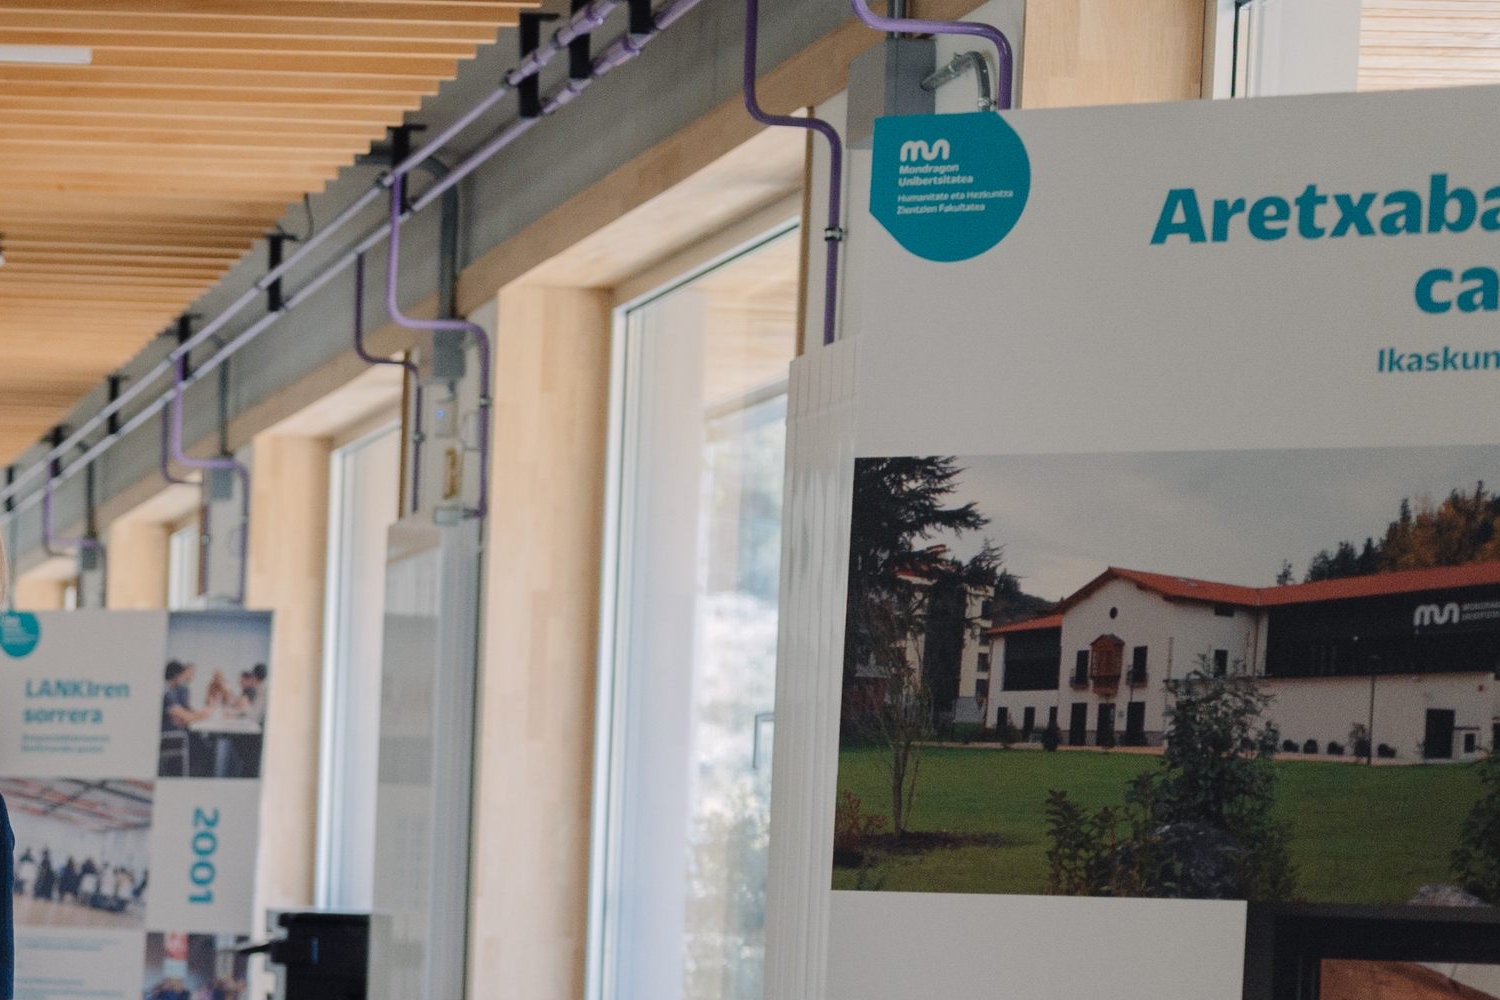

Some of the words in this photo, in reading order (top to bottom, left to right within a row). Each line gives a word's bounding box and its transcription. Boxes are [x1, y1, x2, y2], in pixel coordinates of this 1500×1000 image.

[899, 164, 959, 175] Mondragon
[898, 175, 974, 187] Unibertsitatea
[950, 191, 965, 201] eta
[1414, 267, 1500, 314] ca
[1377, 347, 1500, 373] Ikaskun
[24, 707, 103, 724] sorrera
[189, 807, 219, 904] 2001
